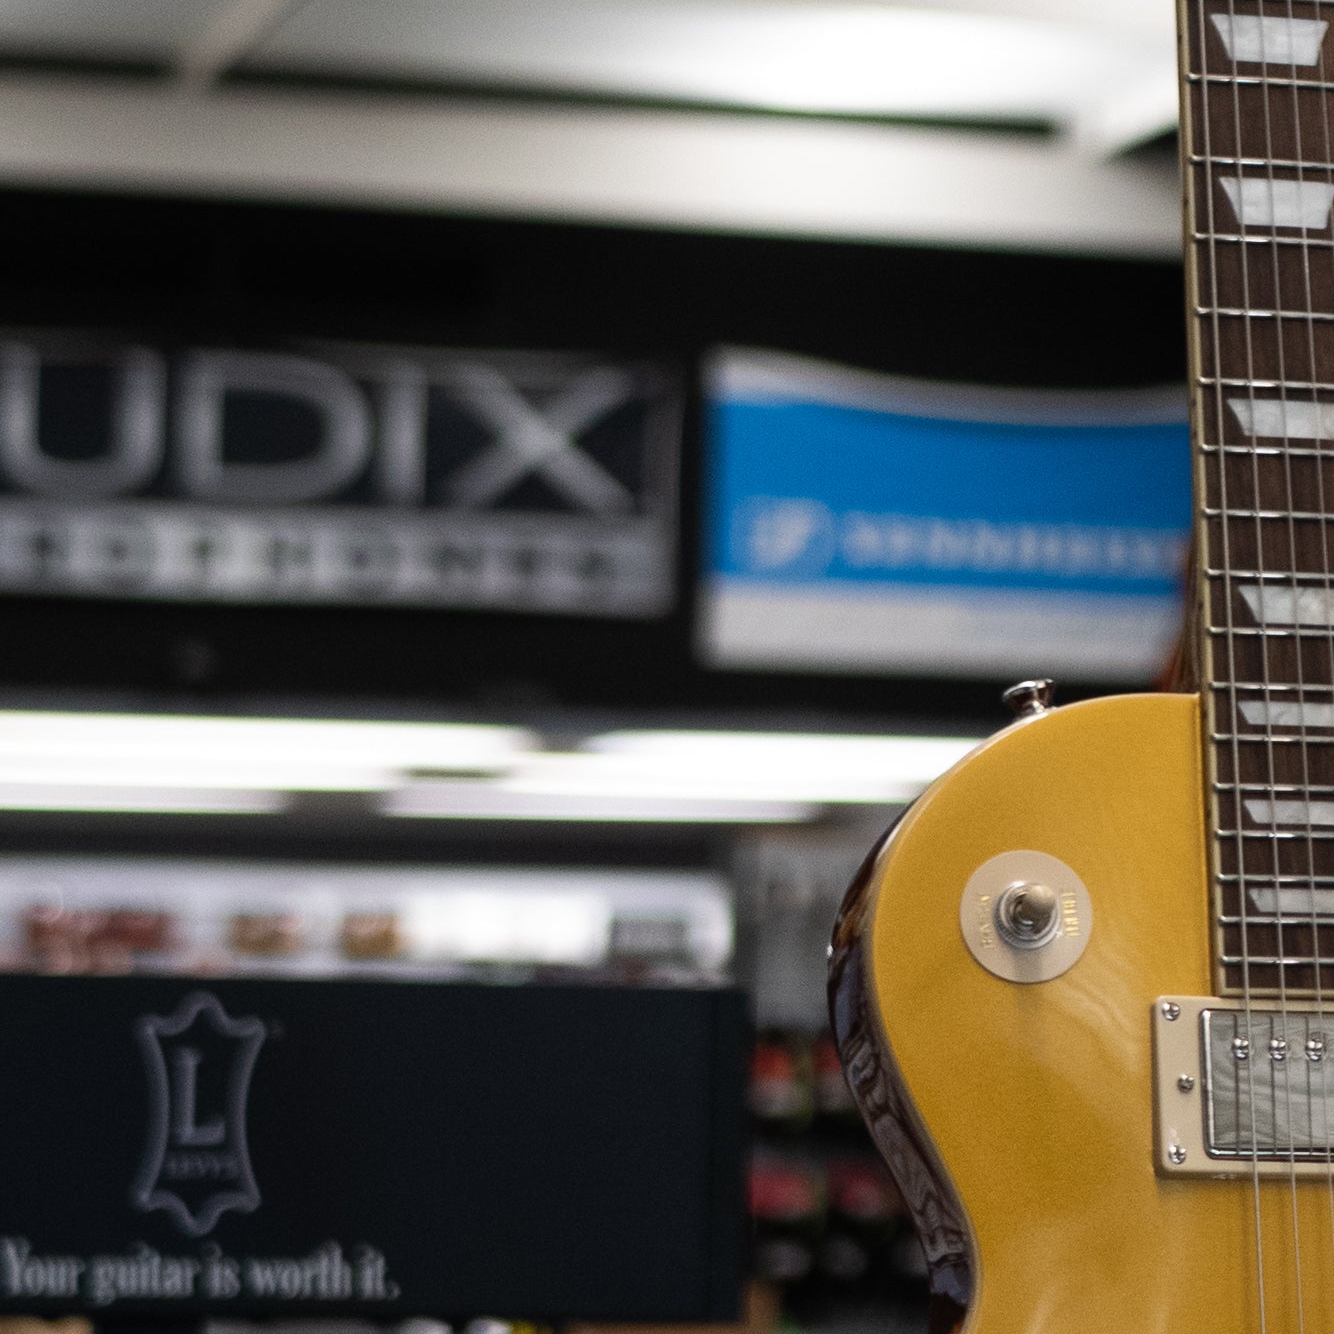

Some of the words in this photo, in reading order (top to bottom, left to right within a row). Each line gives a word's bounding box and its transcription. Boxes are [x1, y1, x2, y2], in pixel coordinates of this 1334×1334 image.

[0, 1236, 84, 1297] Your
[92, 1239, 198, 1307] guitar
[202, 1241, 240, 1299] is
[246, 1239, 353, 1300] worth
